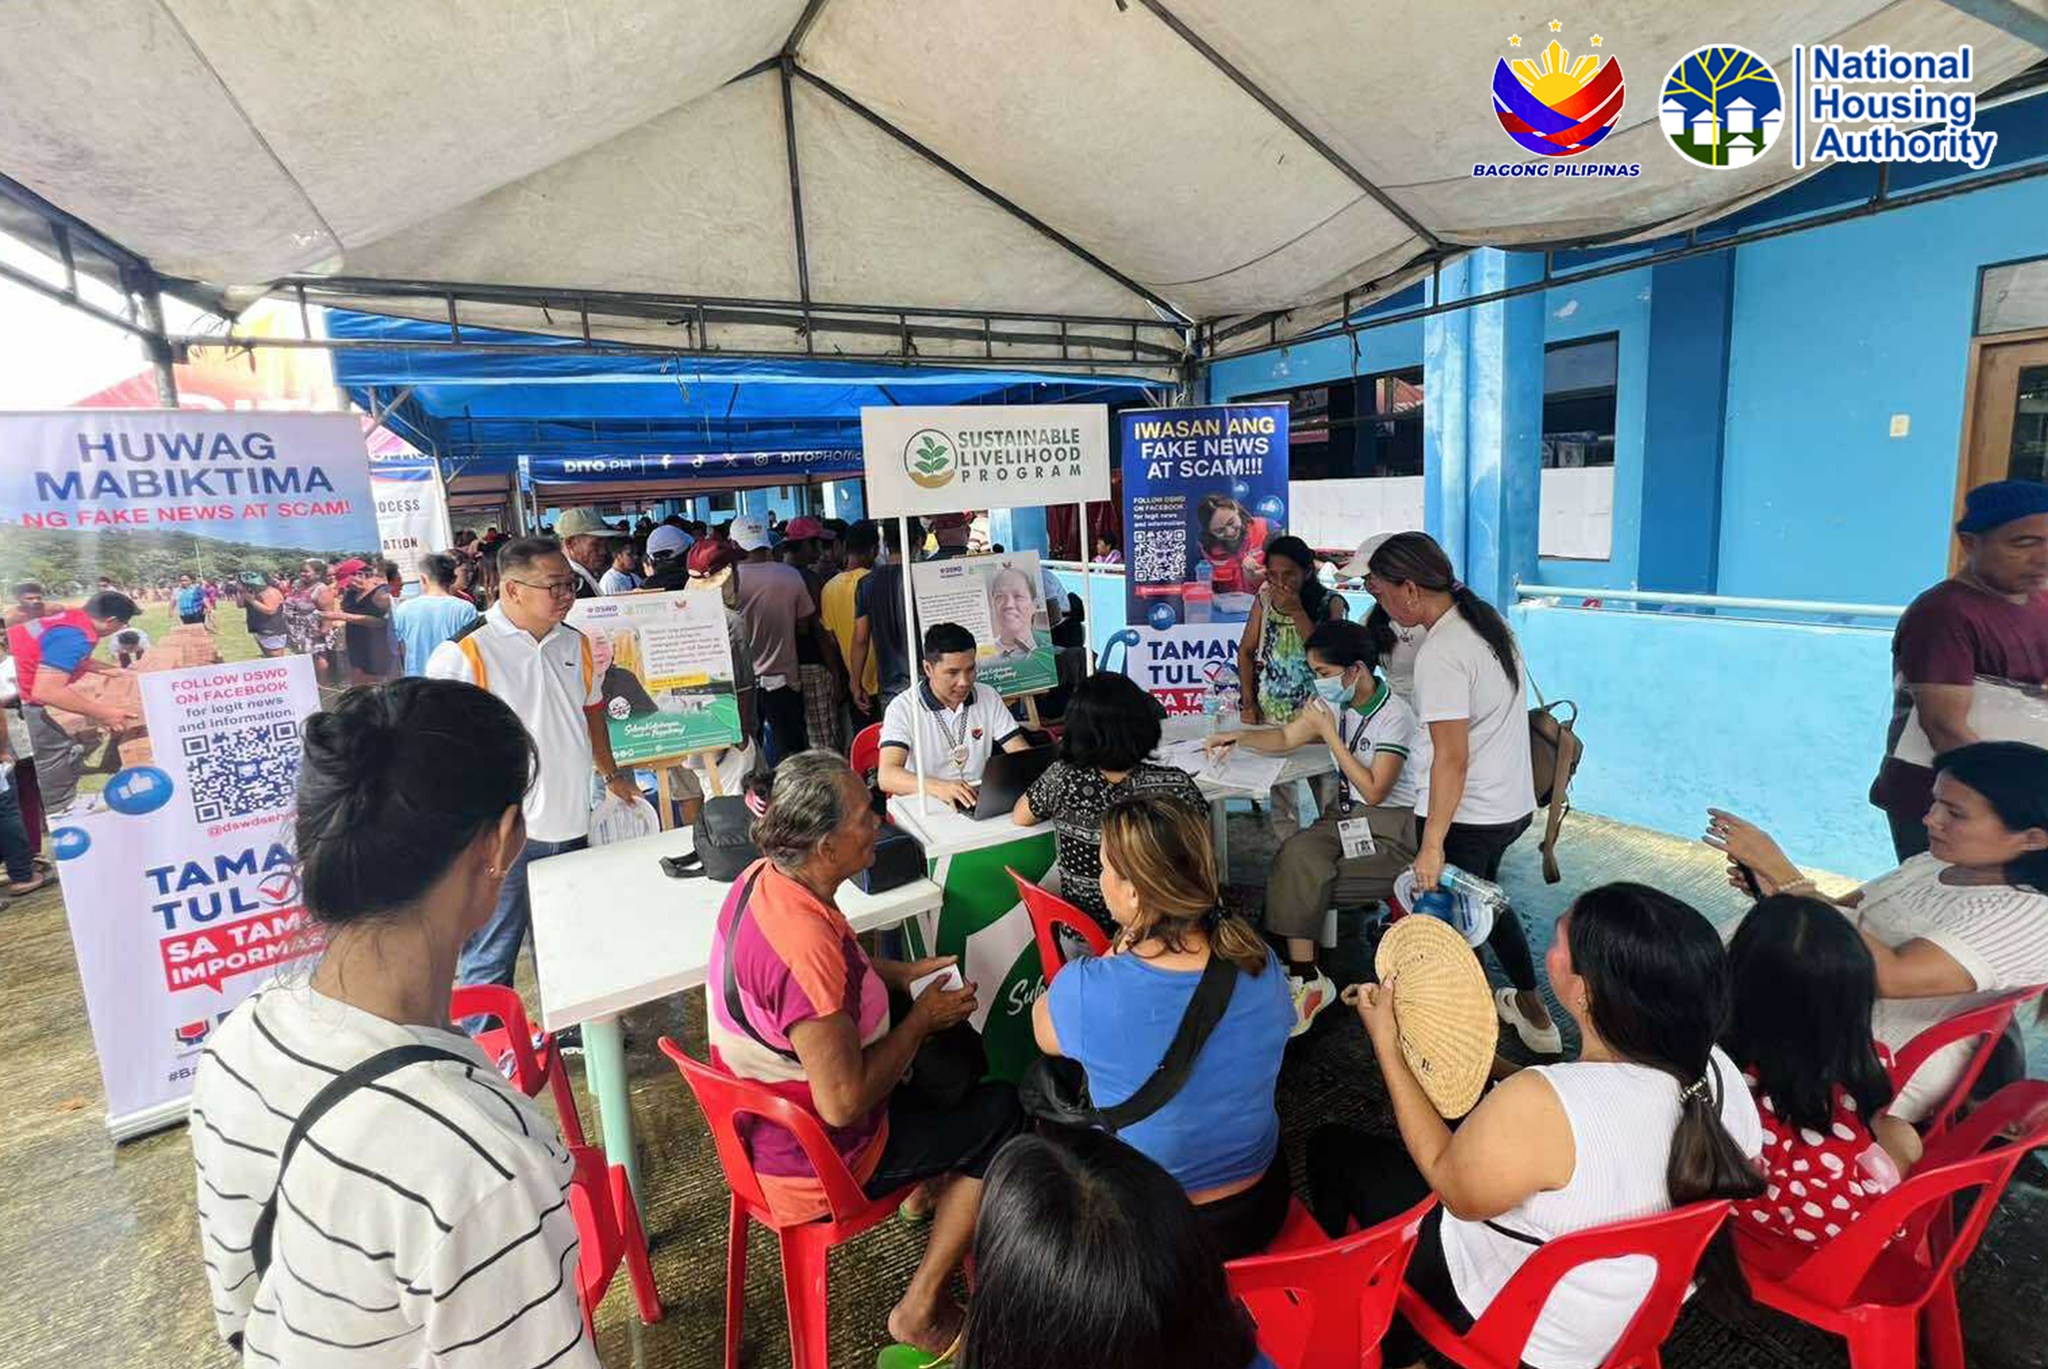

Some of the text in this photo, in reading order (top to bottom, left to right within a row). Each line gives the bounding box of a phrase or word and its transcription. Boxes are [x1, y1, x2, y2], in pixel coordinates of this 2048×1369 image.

[958, 428, 1080, 449] SUSTAINABLE
[1134, 416, 1275, 440] IWASAN ANG
[78, 431, 276, 463] HUWAG
[960, 447, 1081, 467] LIVELIHOOD
[1141, 437, 1269, 460] FAKE NEWS
[962, 464, 1082, 483] PROGRAM
[1147, 458, 1262, 480] AT SCAM!!!
[34, 466, 334, 501] MABIKTIMA
[378, 499, 420, 513] OCESS
[1133, 496, 1163, 504] FOLLOW
[21, 500, 353, 528] NG FAKE NEWS AT SCAM!
[383, 537, 418, 550] ATION
[1147, 639, 1240, 660] TAMAN
[171, 668, 288, 692] FOLLOW DSWD
[176, 681, 289, 705] ON FACEBOOK
[1183, 692, 1205, 706] TA
[186, 697, 284, 718] for legit news
[178, 721, 206, 733] and
[146, 843, 297, 895] TAMA
[167, 911, 303, 963] SA TAM
[171, 936, 324, 985] IMPORMAS
[1006, 975, 1046, 1016] Sul
